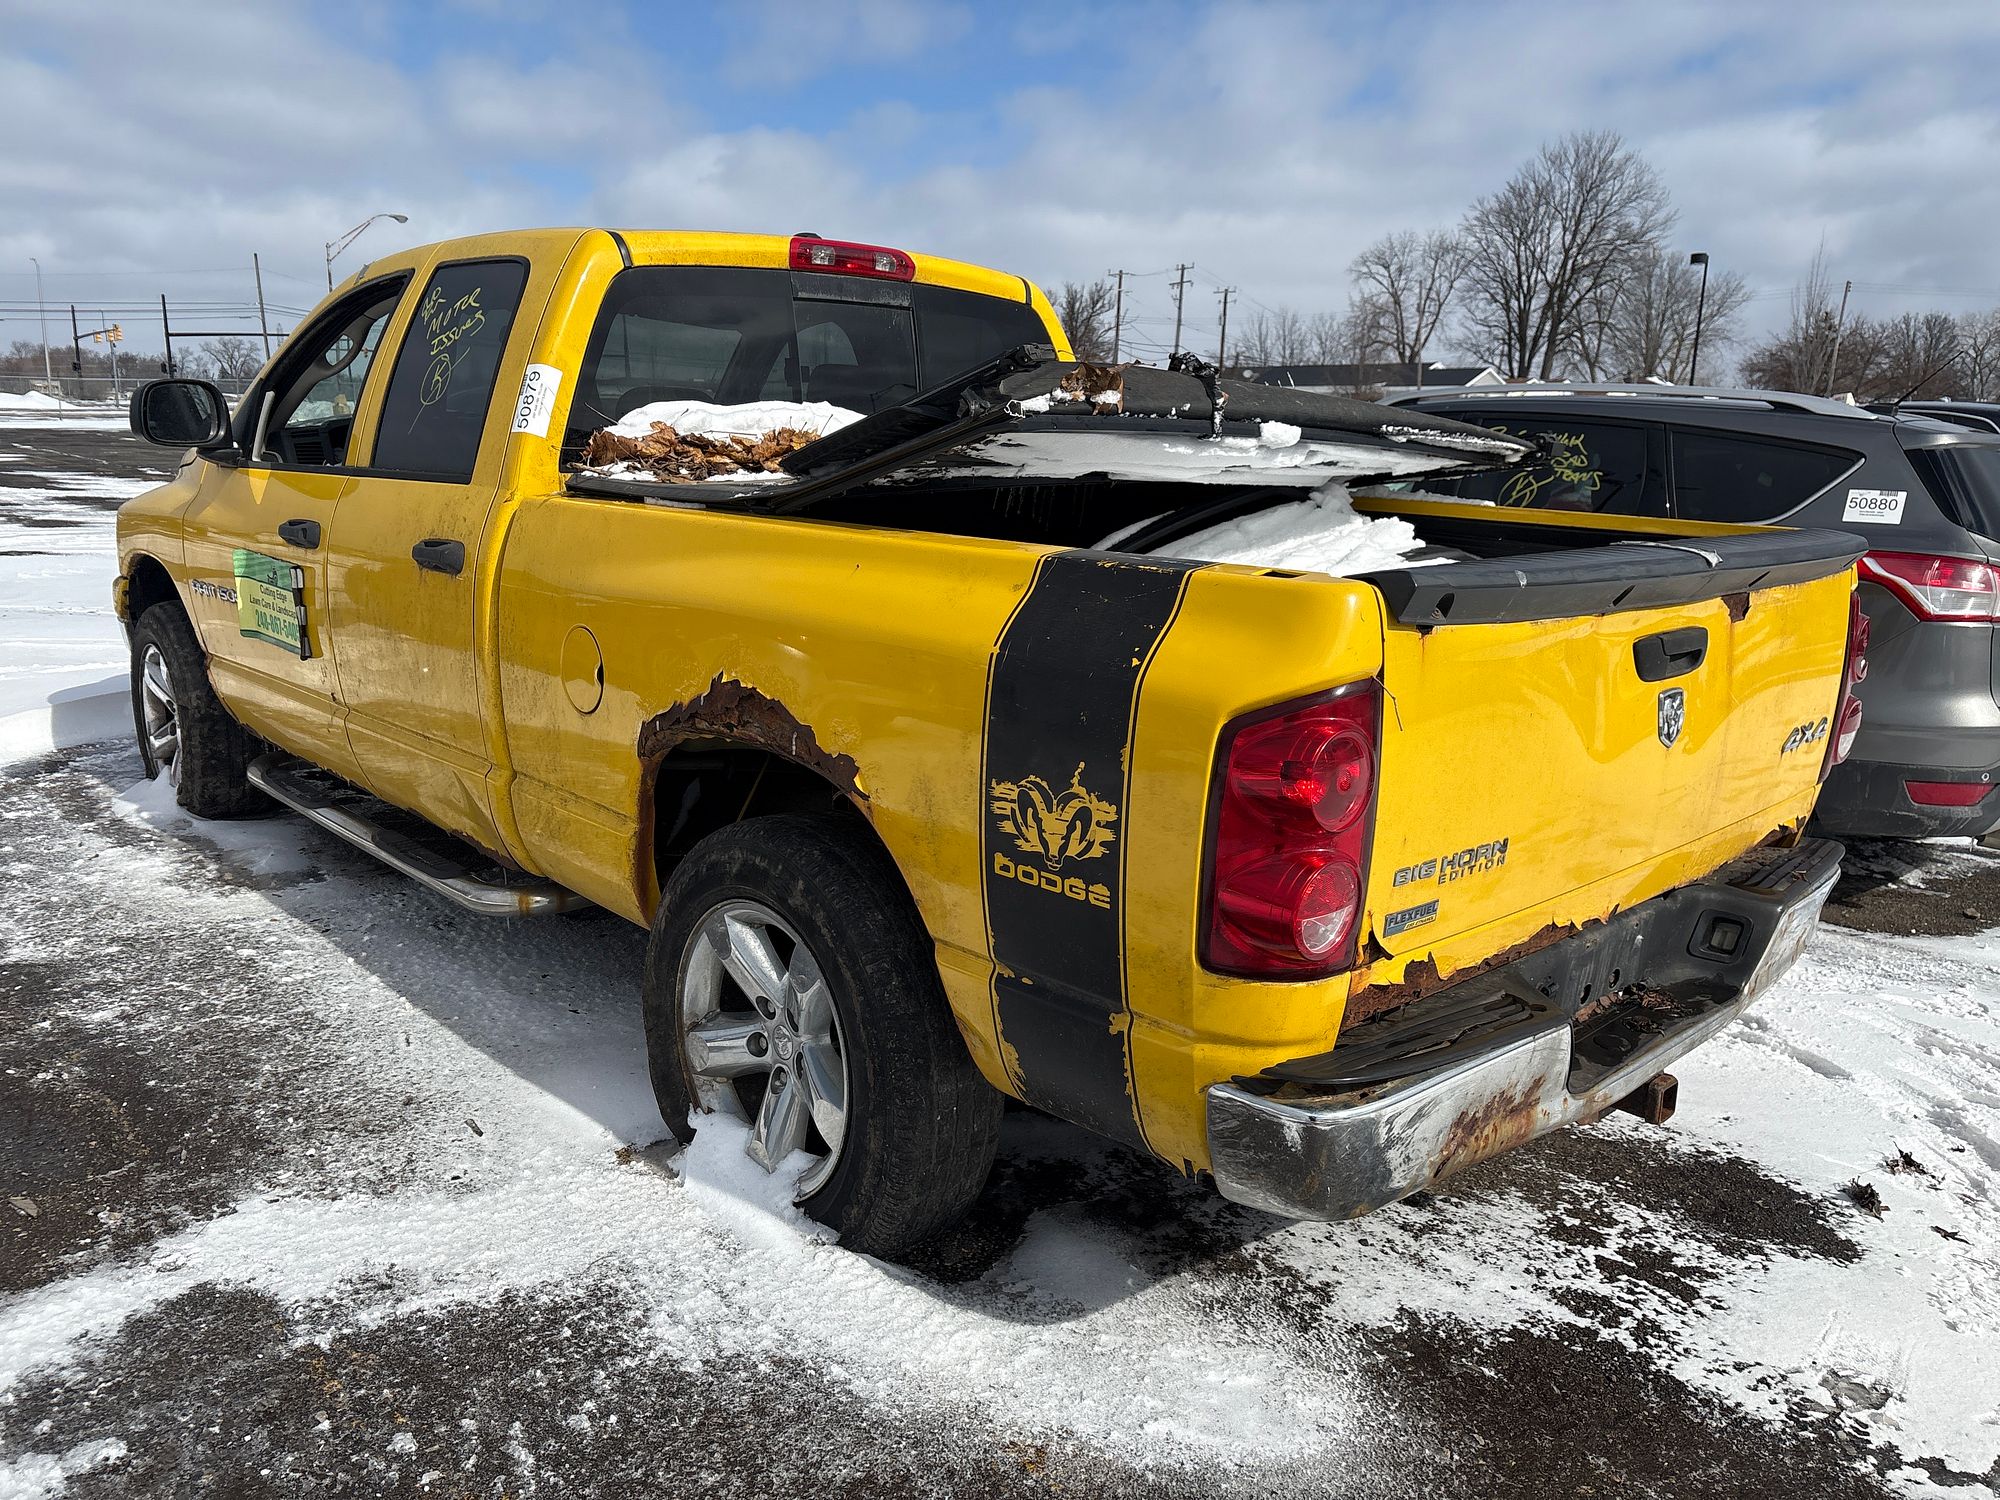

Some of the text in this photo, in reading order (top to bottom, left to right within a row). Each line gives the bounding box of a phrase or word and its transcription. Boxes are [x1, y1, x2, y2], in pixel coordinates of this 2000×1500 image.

[517, 371, 541, 429] 50879
[1848, 496, 1899, 511] 50880
[217, 585, 237, 603] 150
[249, 594, 261, 606] Lawn
[261, 597, 272, 609] Care
[260, 584, 288, 603] Cutting Edge
[1393, 837, 1509, 887] BIG HORN
[1438, 854, 1506, 885] EDITION
[994, 852, 1111, 910] DODGE
[1387, 901, 1438, 927] FLEXFUEL
